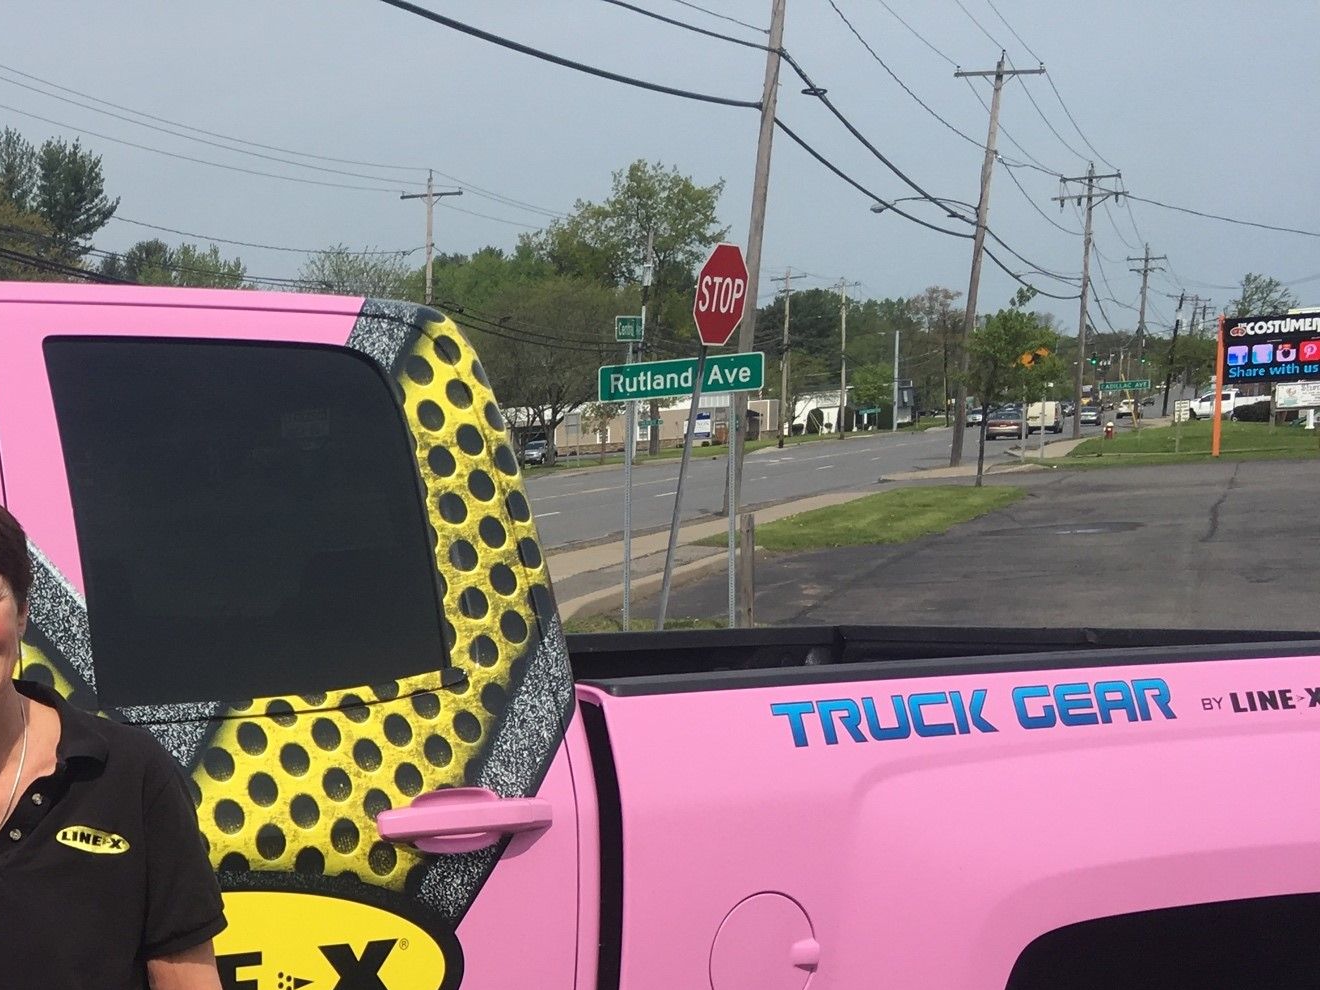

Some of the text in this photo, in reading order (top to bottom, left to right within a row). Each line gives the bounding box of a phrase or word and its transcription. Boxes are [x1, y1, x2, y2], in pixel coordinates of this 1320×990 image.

[699, 275, 744, 313] STOP
[610, 364, 751, 393] Rutland Ave
[1228, 363, 1319, 378] Share with us
[770, 689, 999, 747] TRUCK
[1012, 678, 1177, 729] GEAR
[1201, 697, 1223, 710] BY
[61, 831, 122, 850] LINE-X
